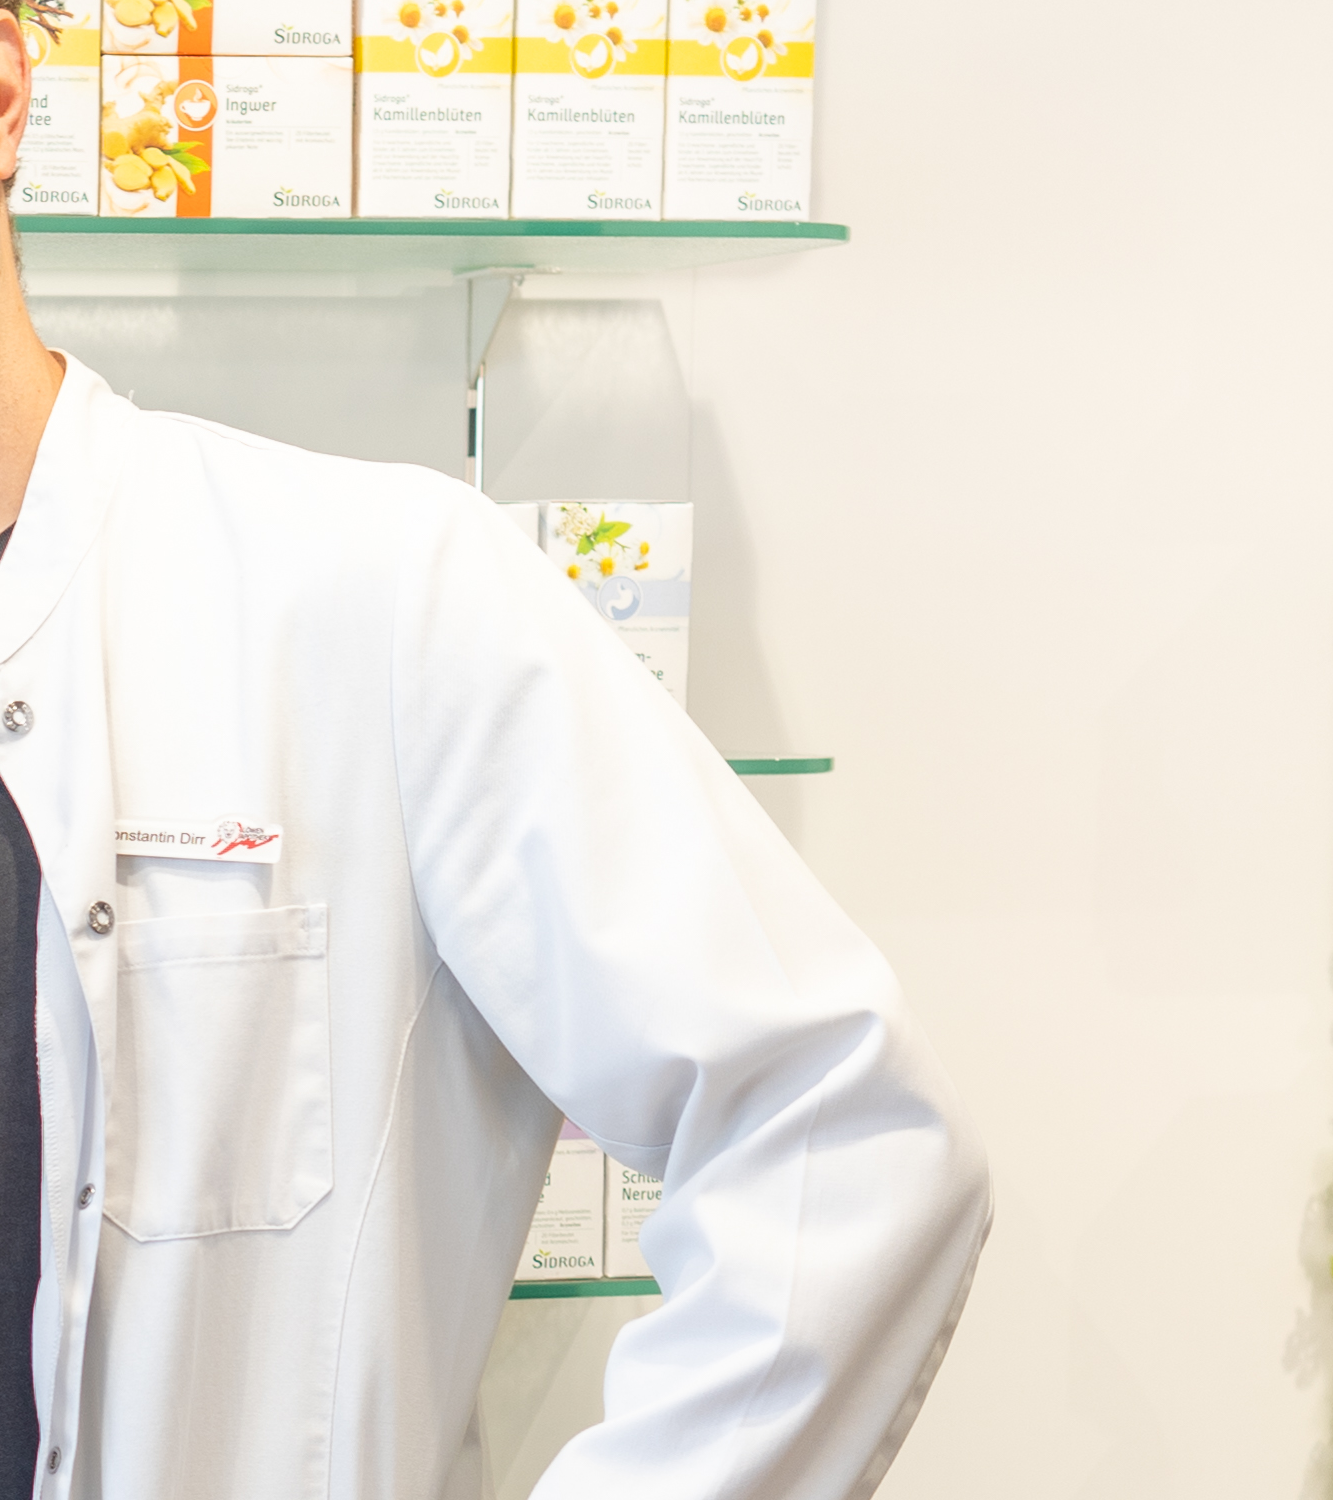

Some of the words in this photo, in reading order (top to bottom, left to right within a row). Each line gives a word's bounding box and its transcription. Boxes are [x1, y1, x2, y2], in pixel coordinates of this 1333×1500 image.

[274, 28, 341, 45] SIDROGA
[374, 107, 482, 122] Kamillenblüten
[180, 832, 206, 845] Dirr
